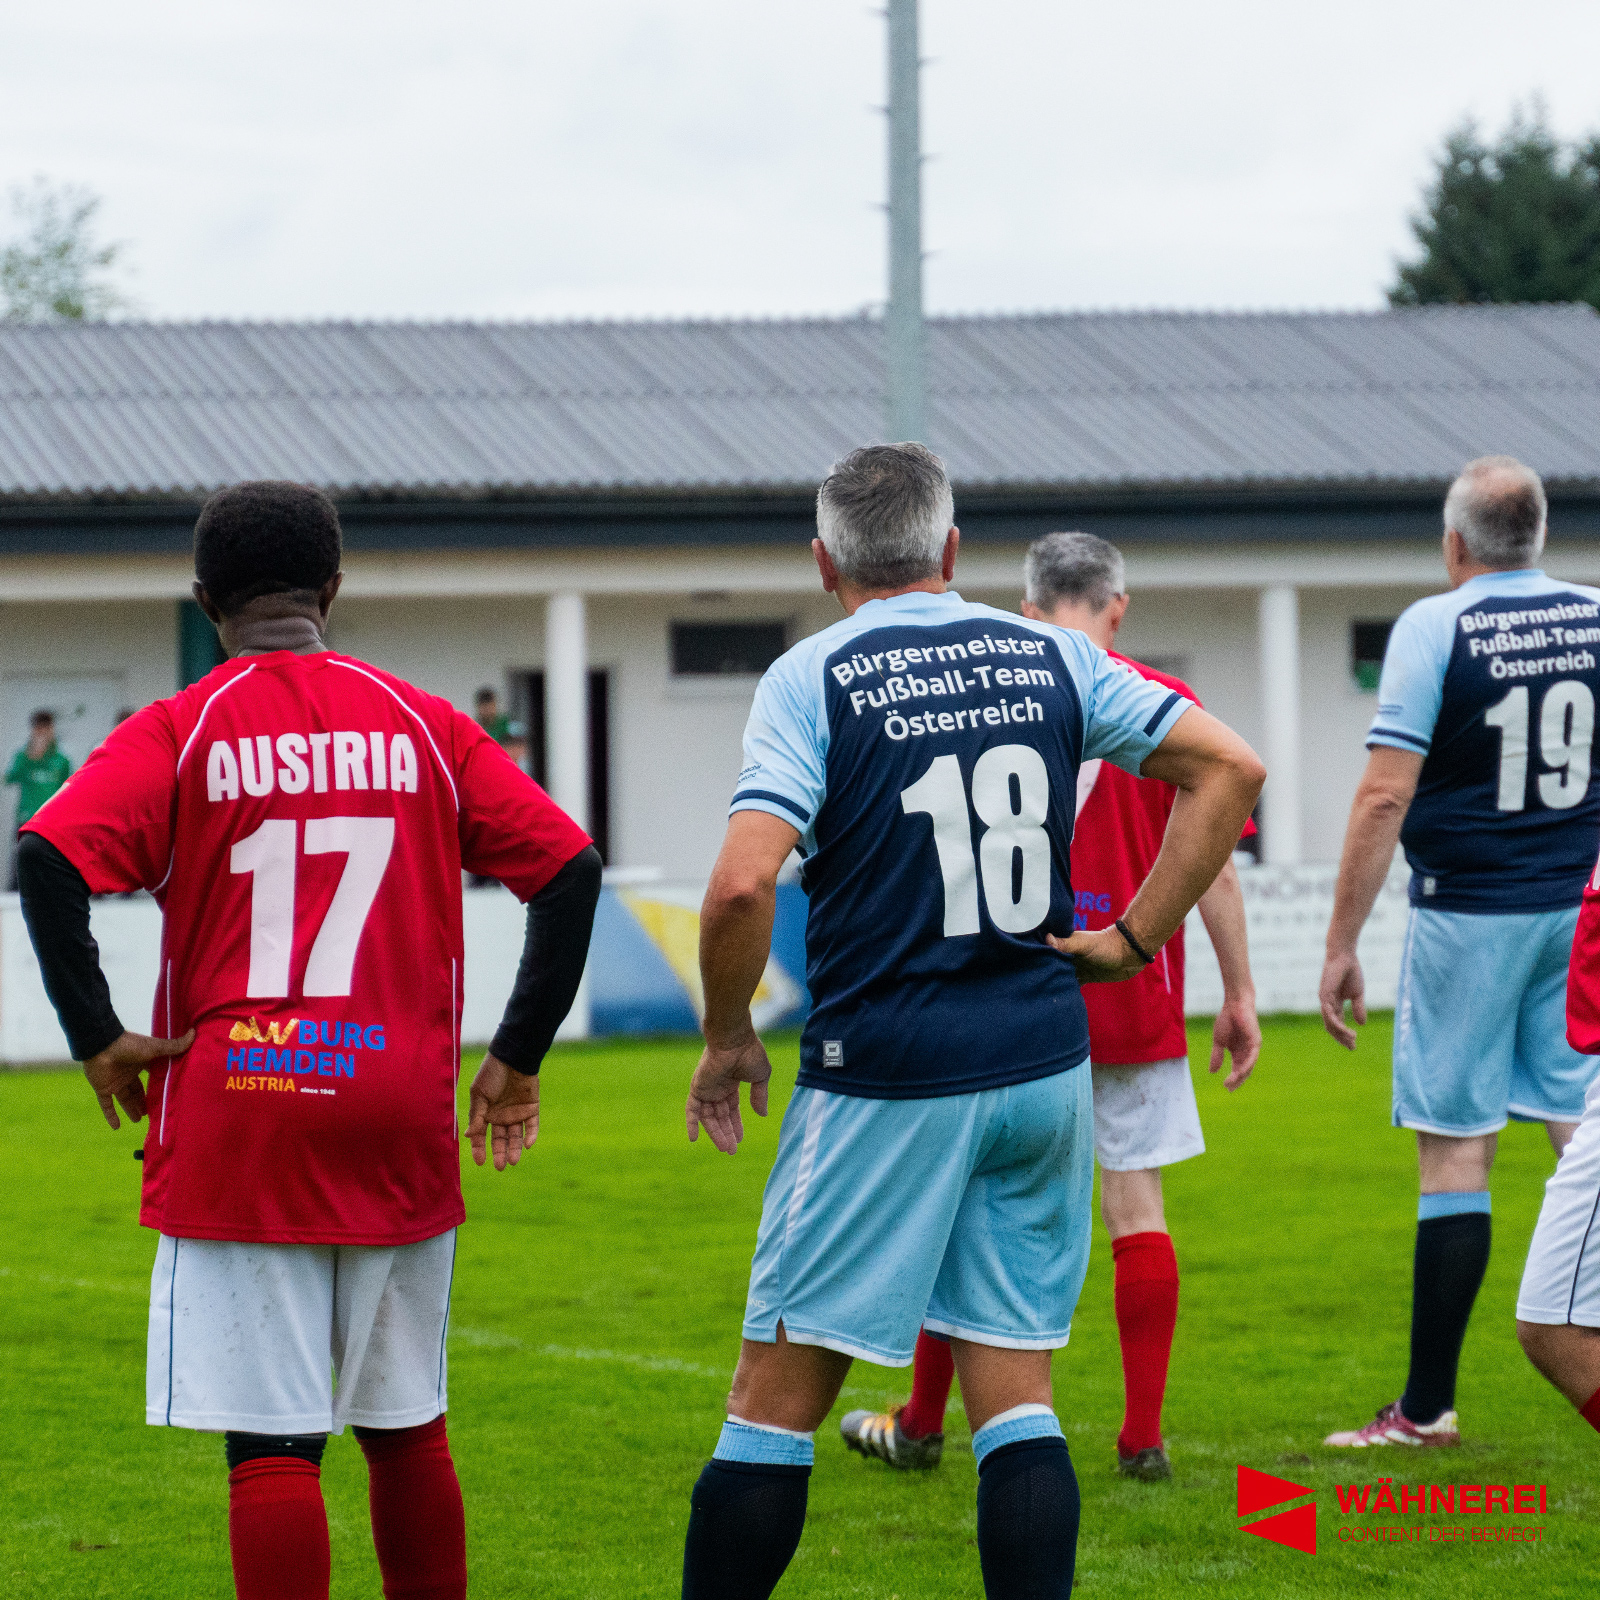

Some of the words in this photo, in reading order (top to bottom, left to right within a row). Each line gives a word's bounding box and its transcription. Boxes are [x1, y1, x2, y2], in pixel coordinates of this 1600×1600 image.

[1460, 602, 1600, 633] Bürgermeister
[831, 634, 1047, 687] Bürgermeister
[1469, 627, 1600, 657] Fußball-Team
[1490, 650, 1595, 679] Österreich
[849, 665, 1055, 716] Fußball-Team
[884, 696, 1043, 740] Österreich
[207, 731, 418, 802] AUSTRIA
[1484, 681, 1594, 812] 19
[901, 744, 1050, 937] 18
[230, 816, 395, 998] 17
[226, 1047, 355, 1077] HEMDEN
[226, 1076, 296, 1093] AUSTRIA
[300, 1086, 319, 1094] since
